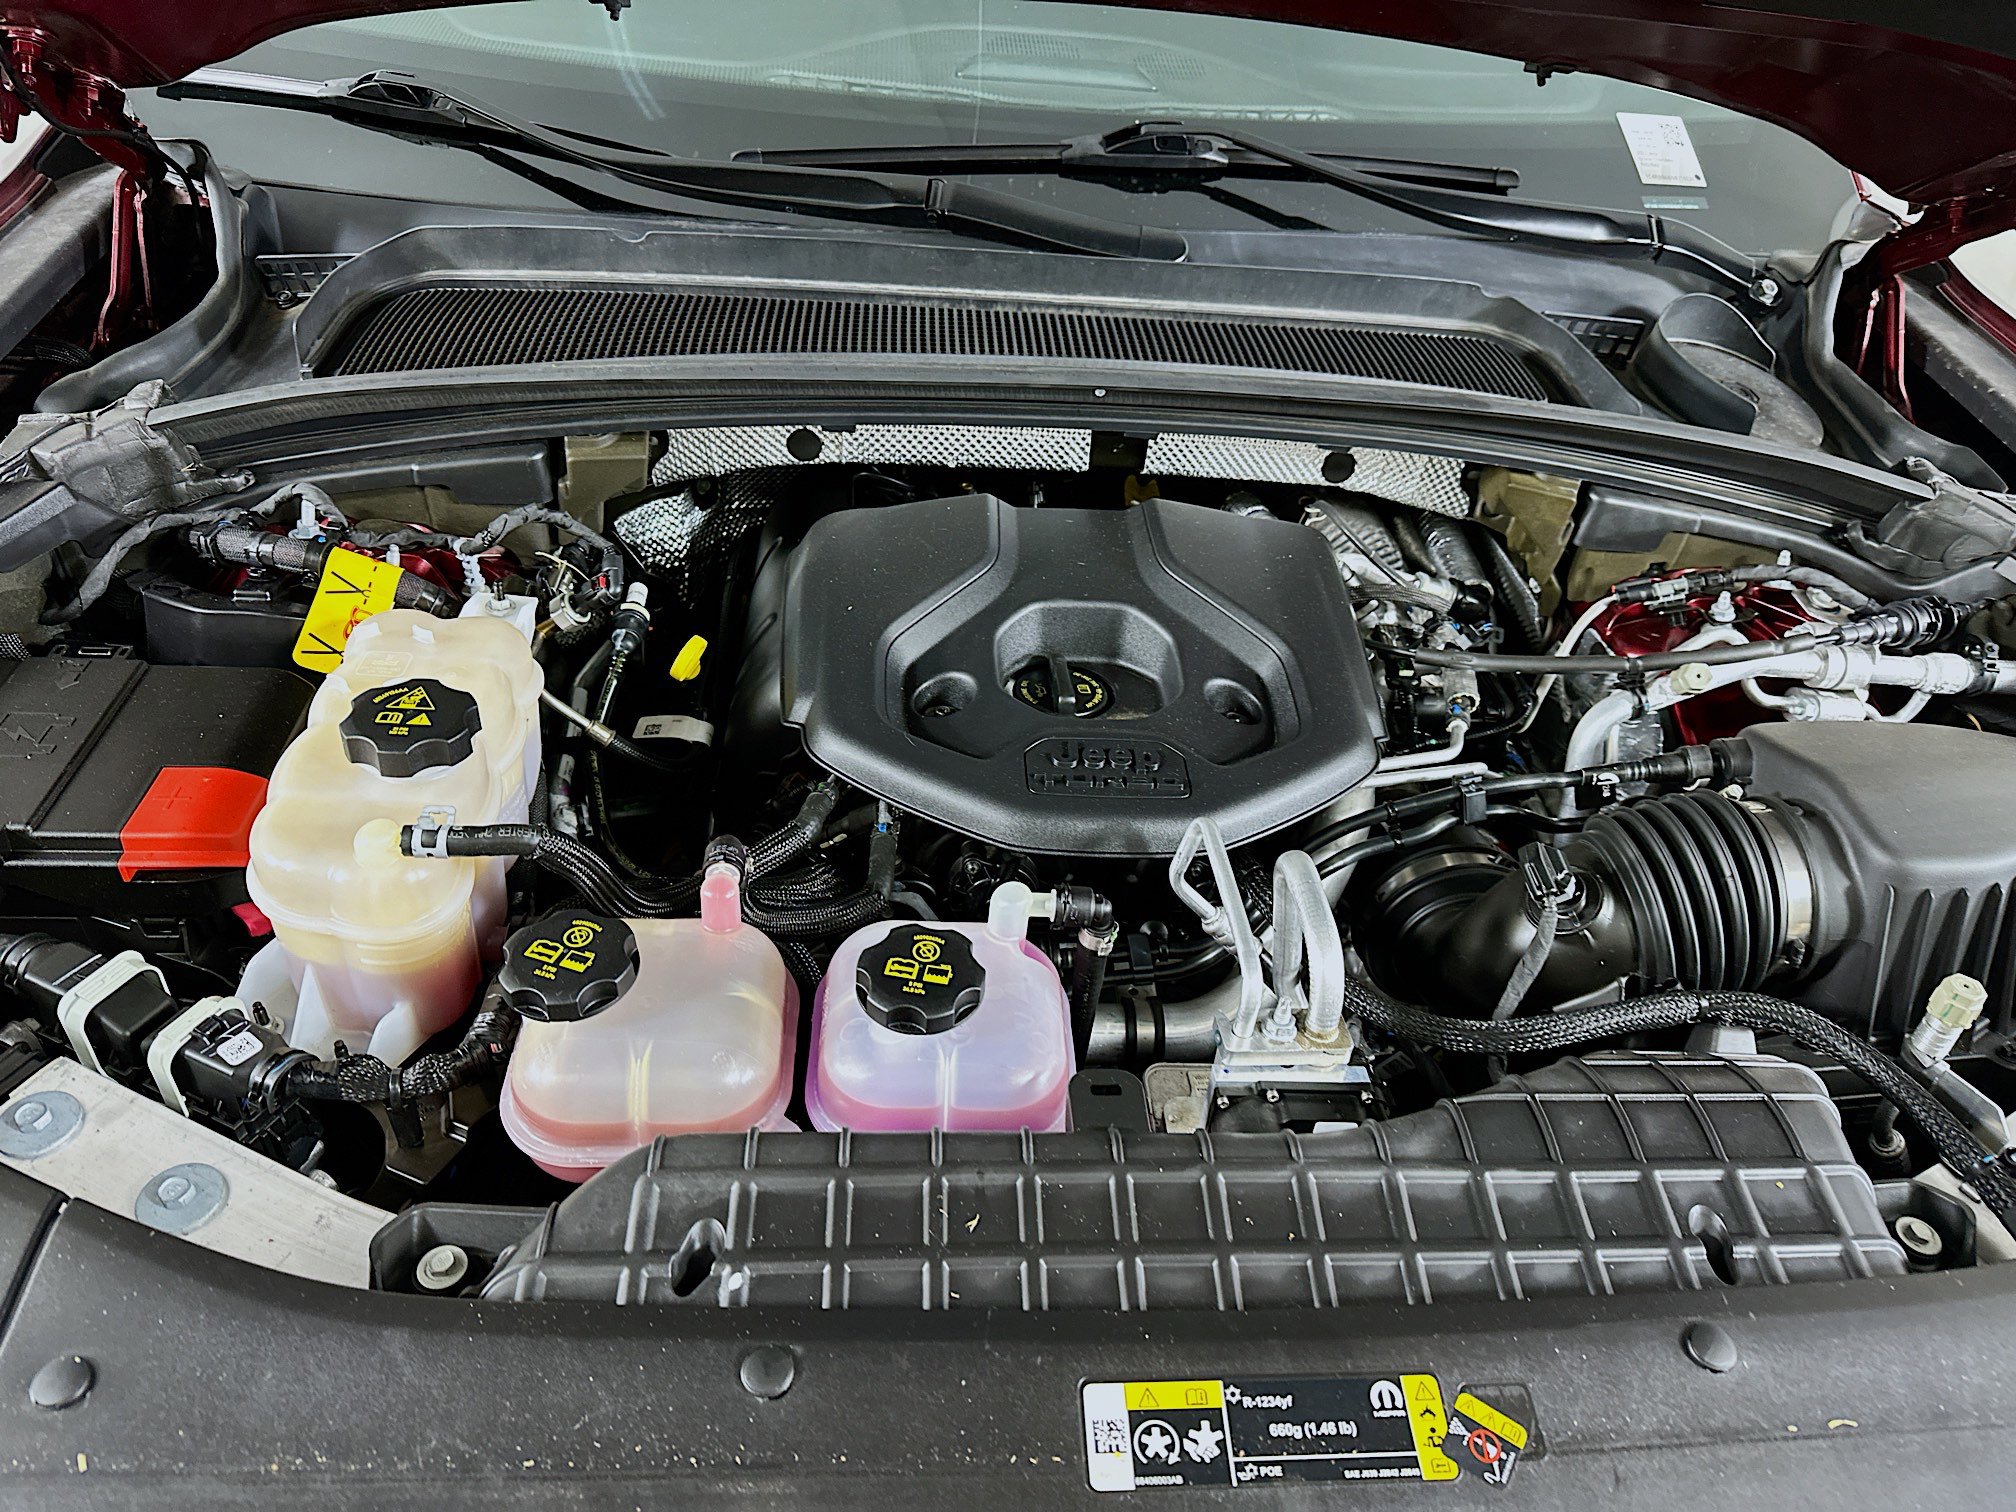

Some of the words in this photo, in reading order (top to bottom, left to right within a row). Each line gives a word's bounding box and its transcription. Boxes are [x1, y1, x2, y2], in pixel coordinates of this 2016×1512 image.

[1050, 740, 1162, 775] Jeep
[1030, 772, 1187, 791] TURBO
[499, 827, 537, 838] HEATER
[1242, 1395, 1293, 1410] R-1234yf
[1269, 1422, 1303, 1439] 660g
[1304, 1422, 1338, 1439] (1.46
[1338, 1420, 1358, 1438] lb)
[1259, 1465, 1284, 1477] POE
